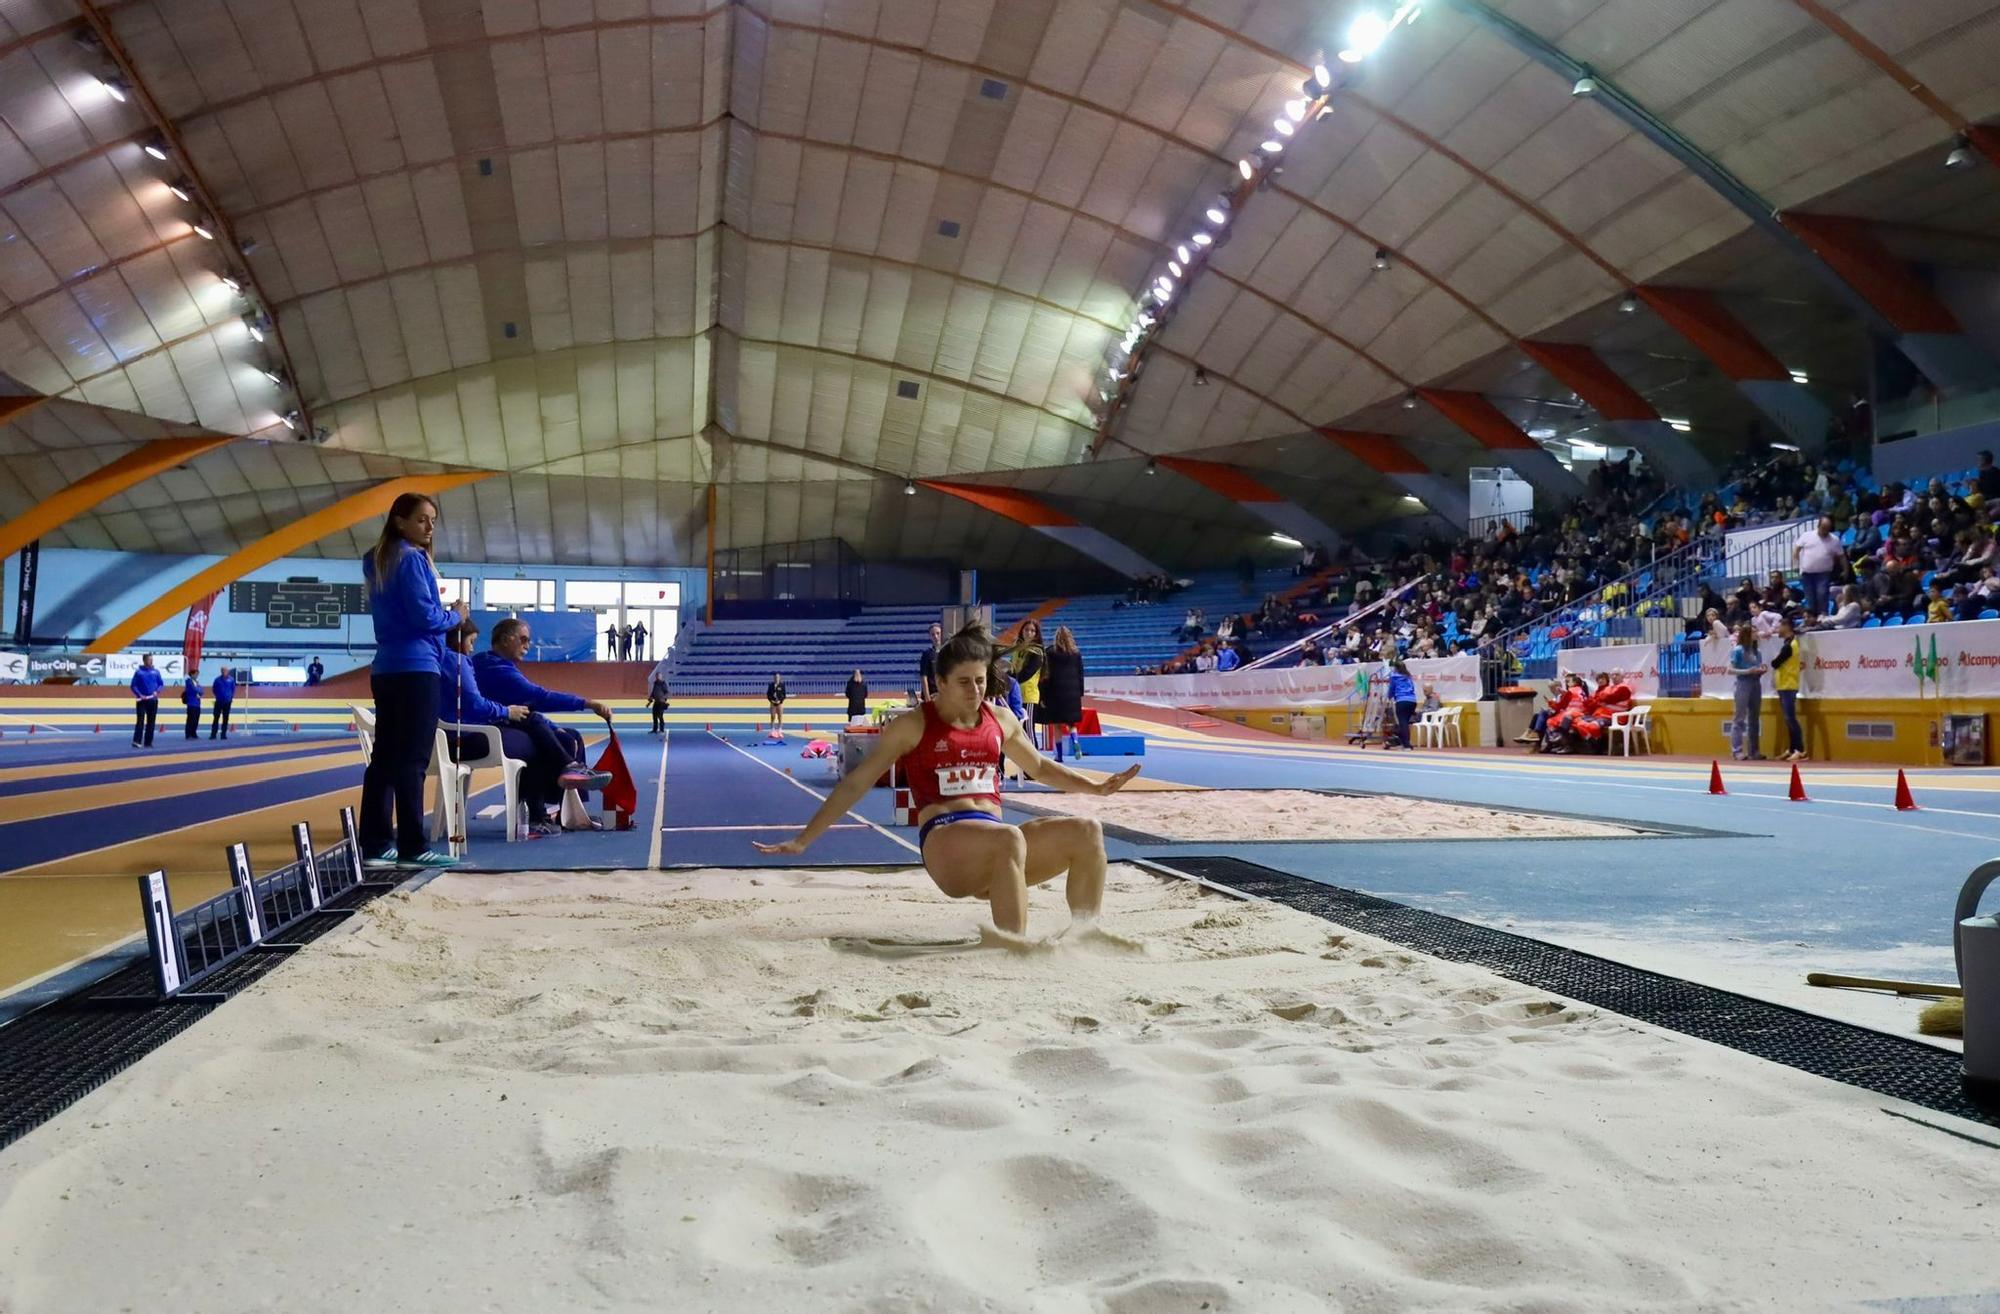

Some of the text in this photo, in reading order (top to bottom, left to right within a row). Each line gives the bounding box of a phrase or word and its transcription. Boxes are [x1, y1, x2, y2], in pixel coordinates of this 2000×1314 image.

[1814, 656, 1850, 671] Alcampo
[1857, 654, 1898, 670] Alcampo
[303, 844, 314, 889] 5
[240, 866, 253, 920] 6
